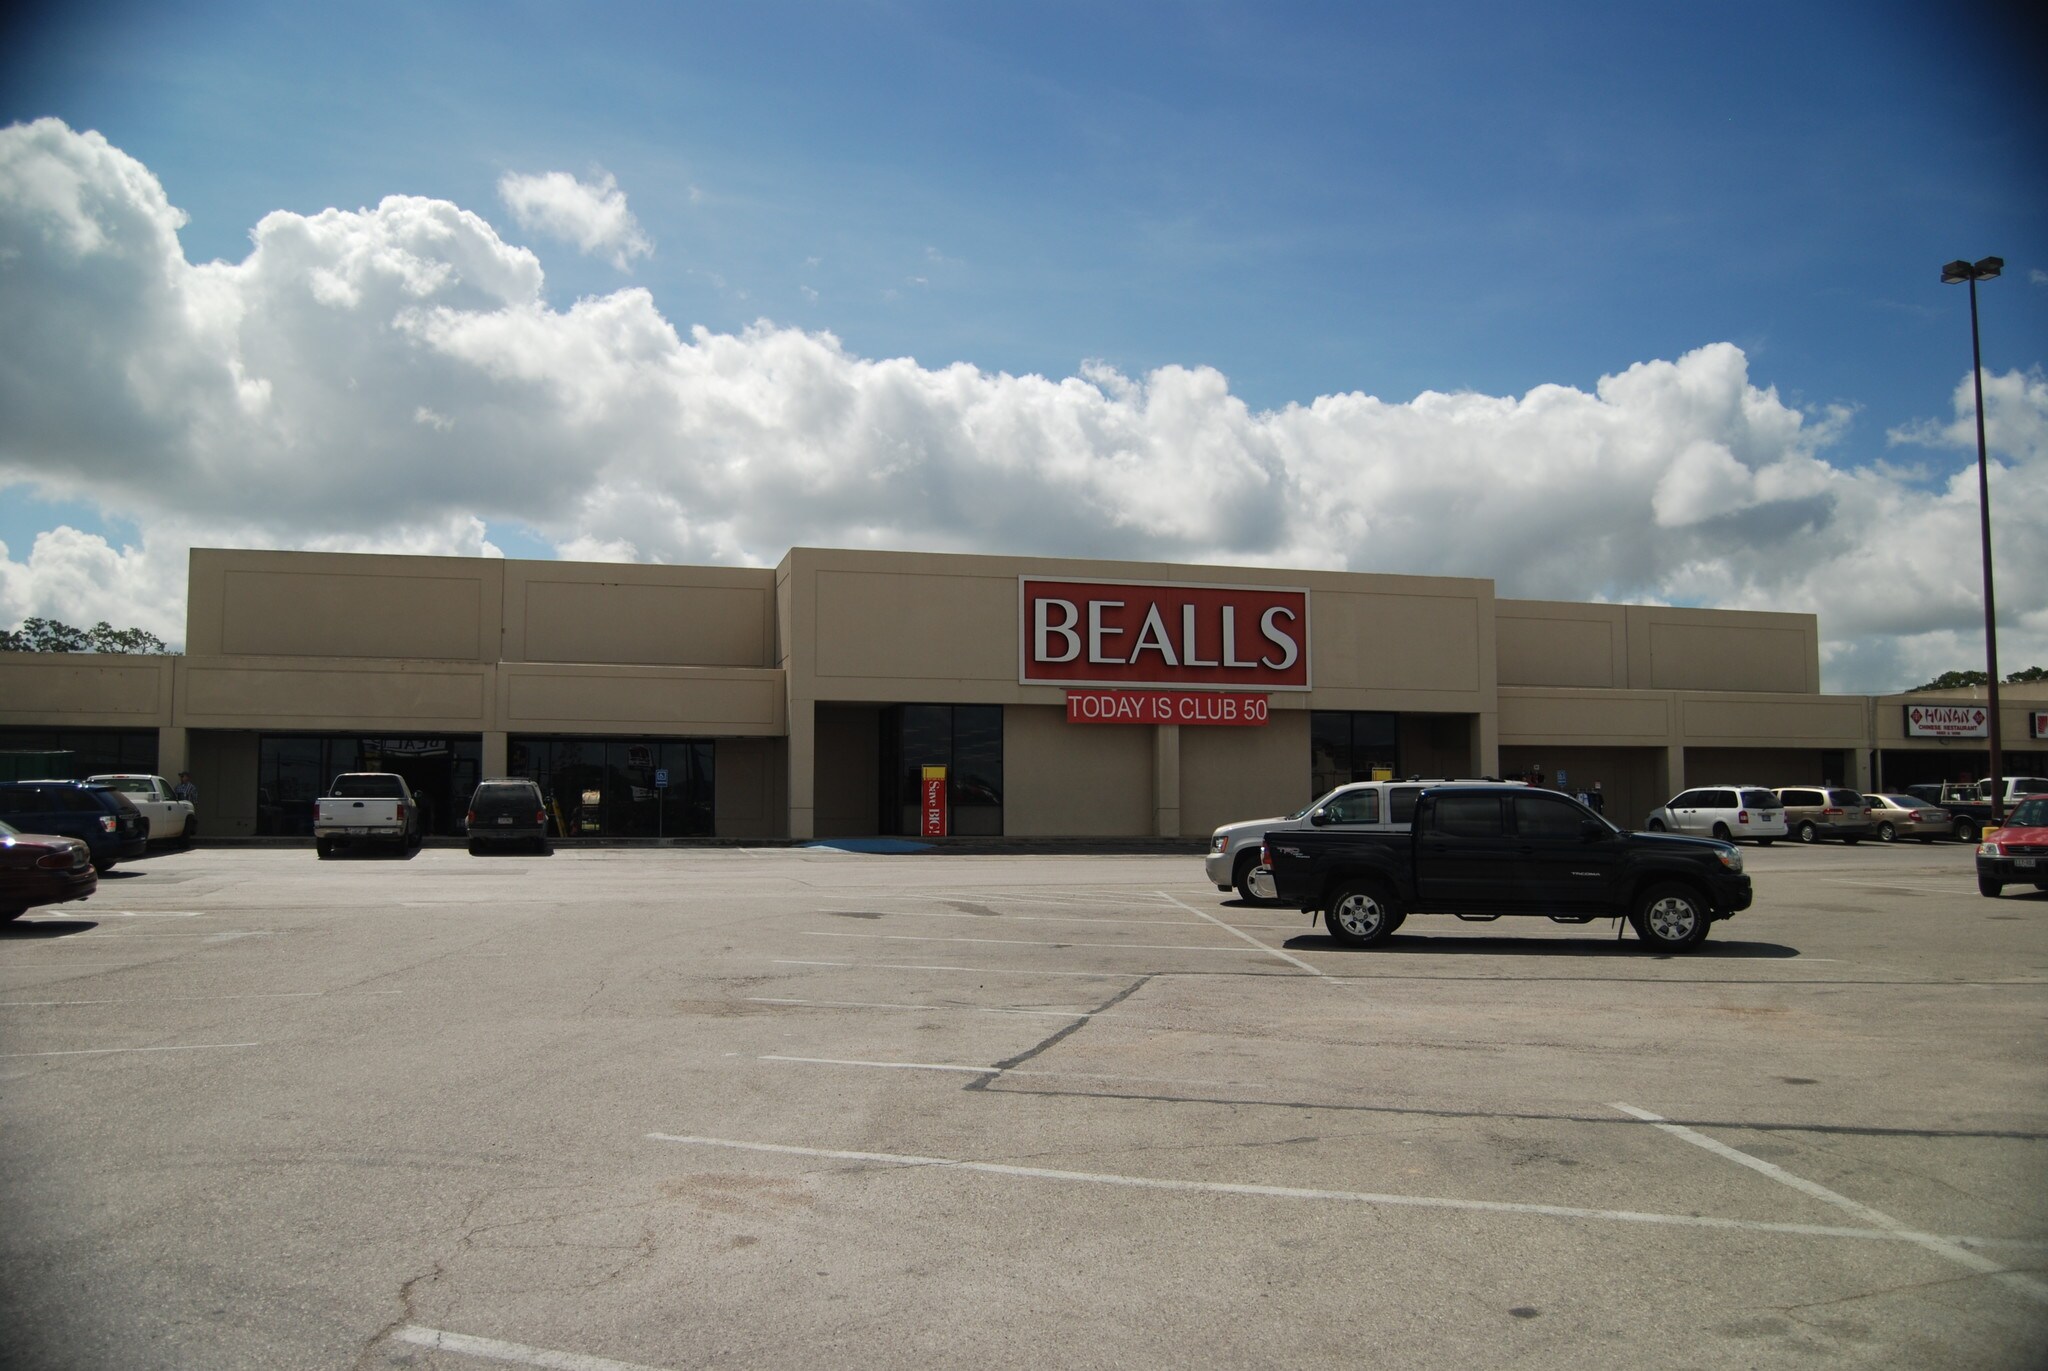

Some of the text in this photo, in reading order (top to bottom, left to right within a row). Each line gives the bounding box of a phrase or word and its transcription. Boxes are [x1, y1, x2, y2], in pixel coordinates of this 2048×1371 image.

[1034, 598, 1298, 670] BEALLS
[1068, 696, 1267, 721] TODAY IS CLUB 50
[1925, 708, 1970, 723] HUNAN
[929, 781, 940, 834] Save BIG!
